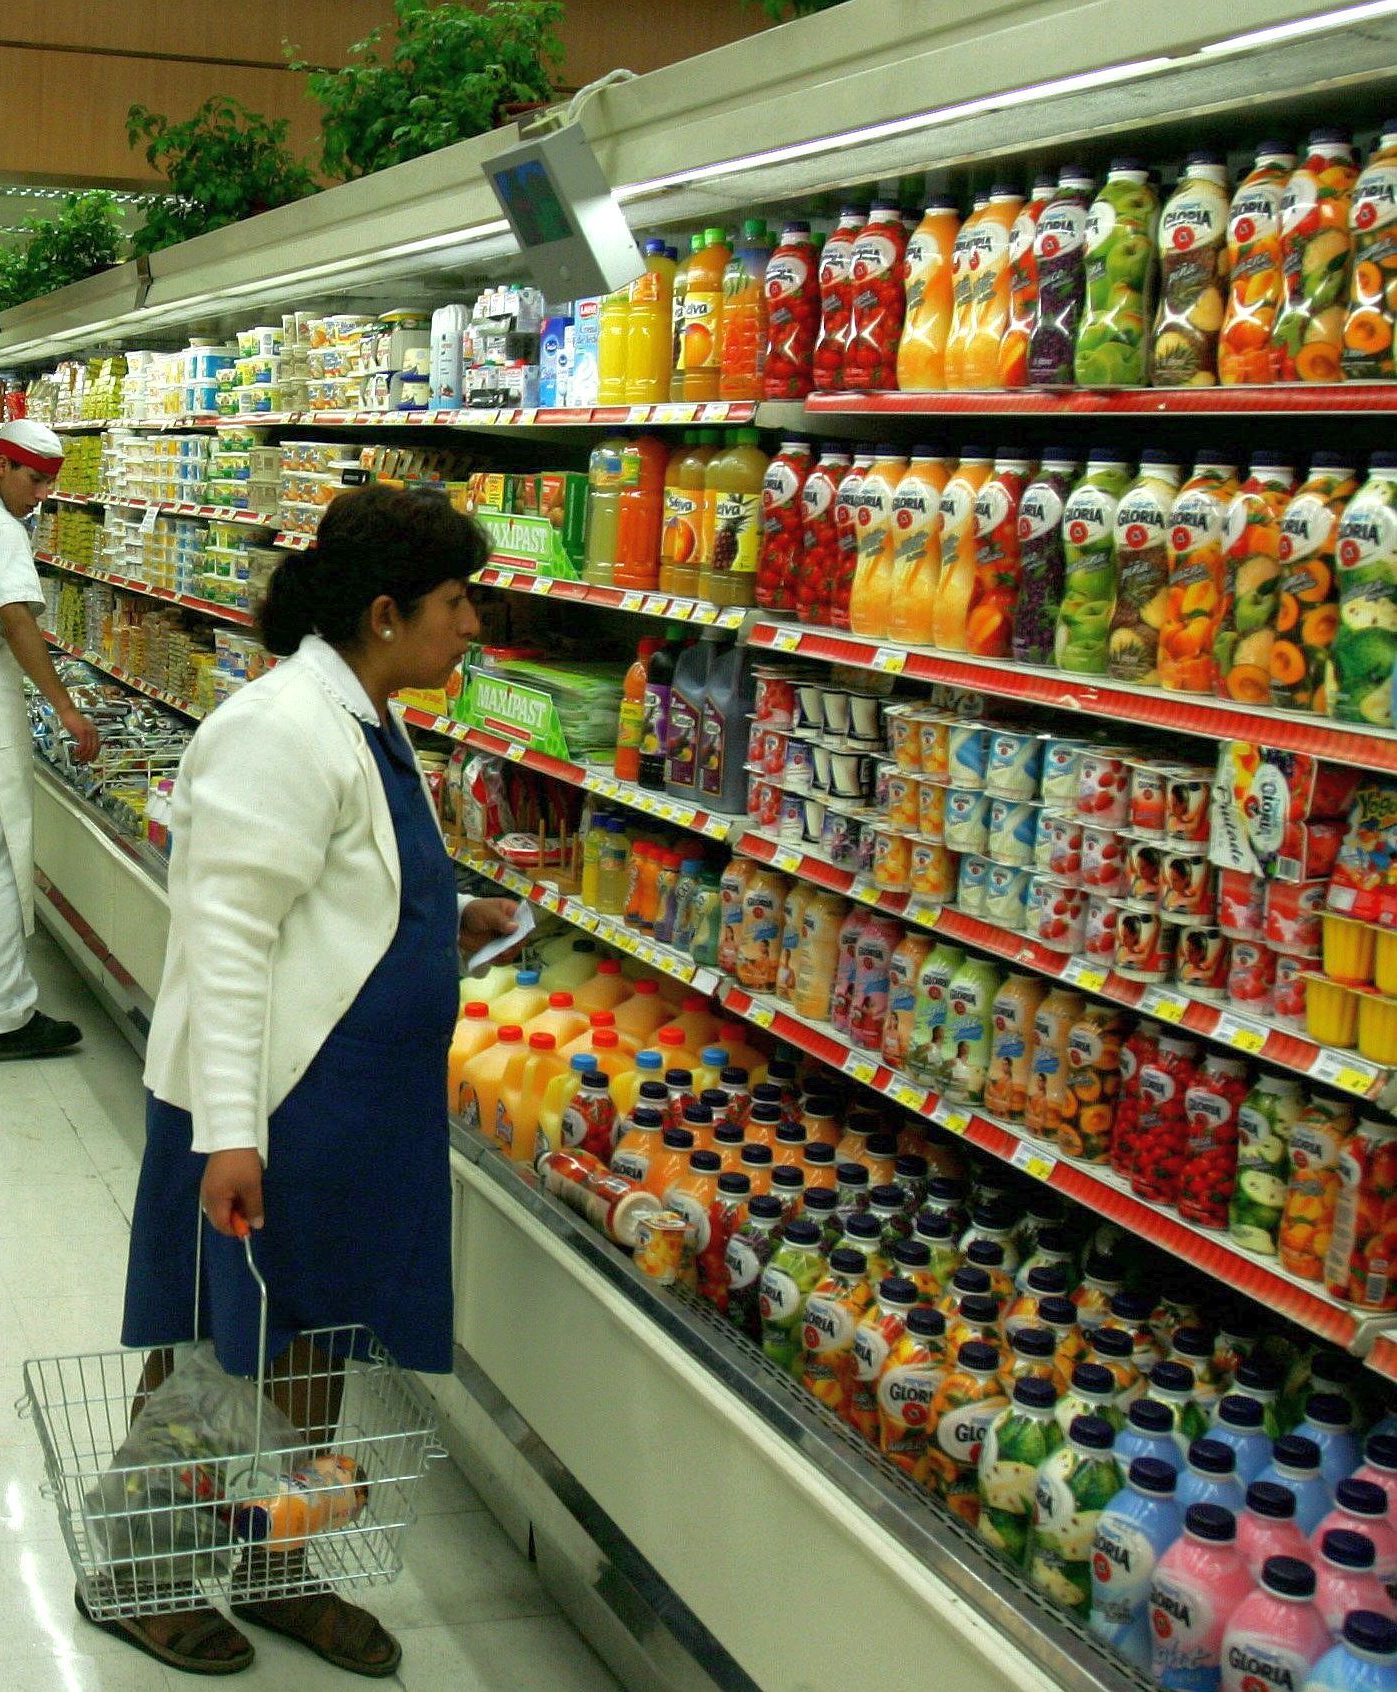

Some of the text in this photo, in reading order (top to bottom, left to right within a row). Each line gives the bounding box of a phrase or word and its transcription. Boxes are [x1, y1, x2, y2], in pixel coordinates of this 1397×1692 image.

[1065, 508, 1104, 526] GLORIA
[1118, 510, 1166, 529] GLORIA
[477, 682, 546, 729] MAXIPAST
[954, 1421, 988, 1443] GLO
[1228, 1646, 1294, 1691] GLORIA
